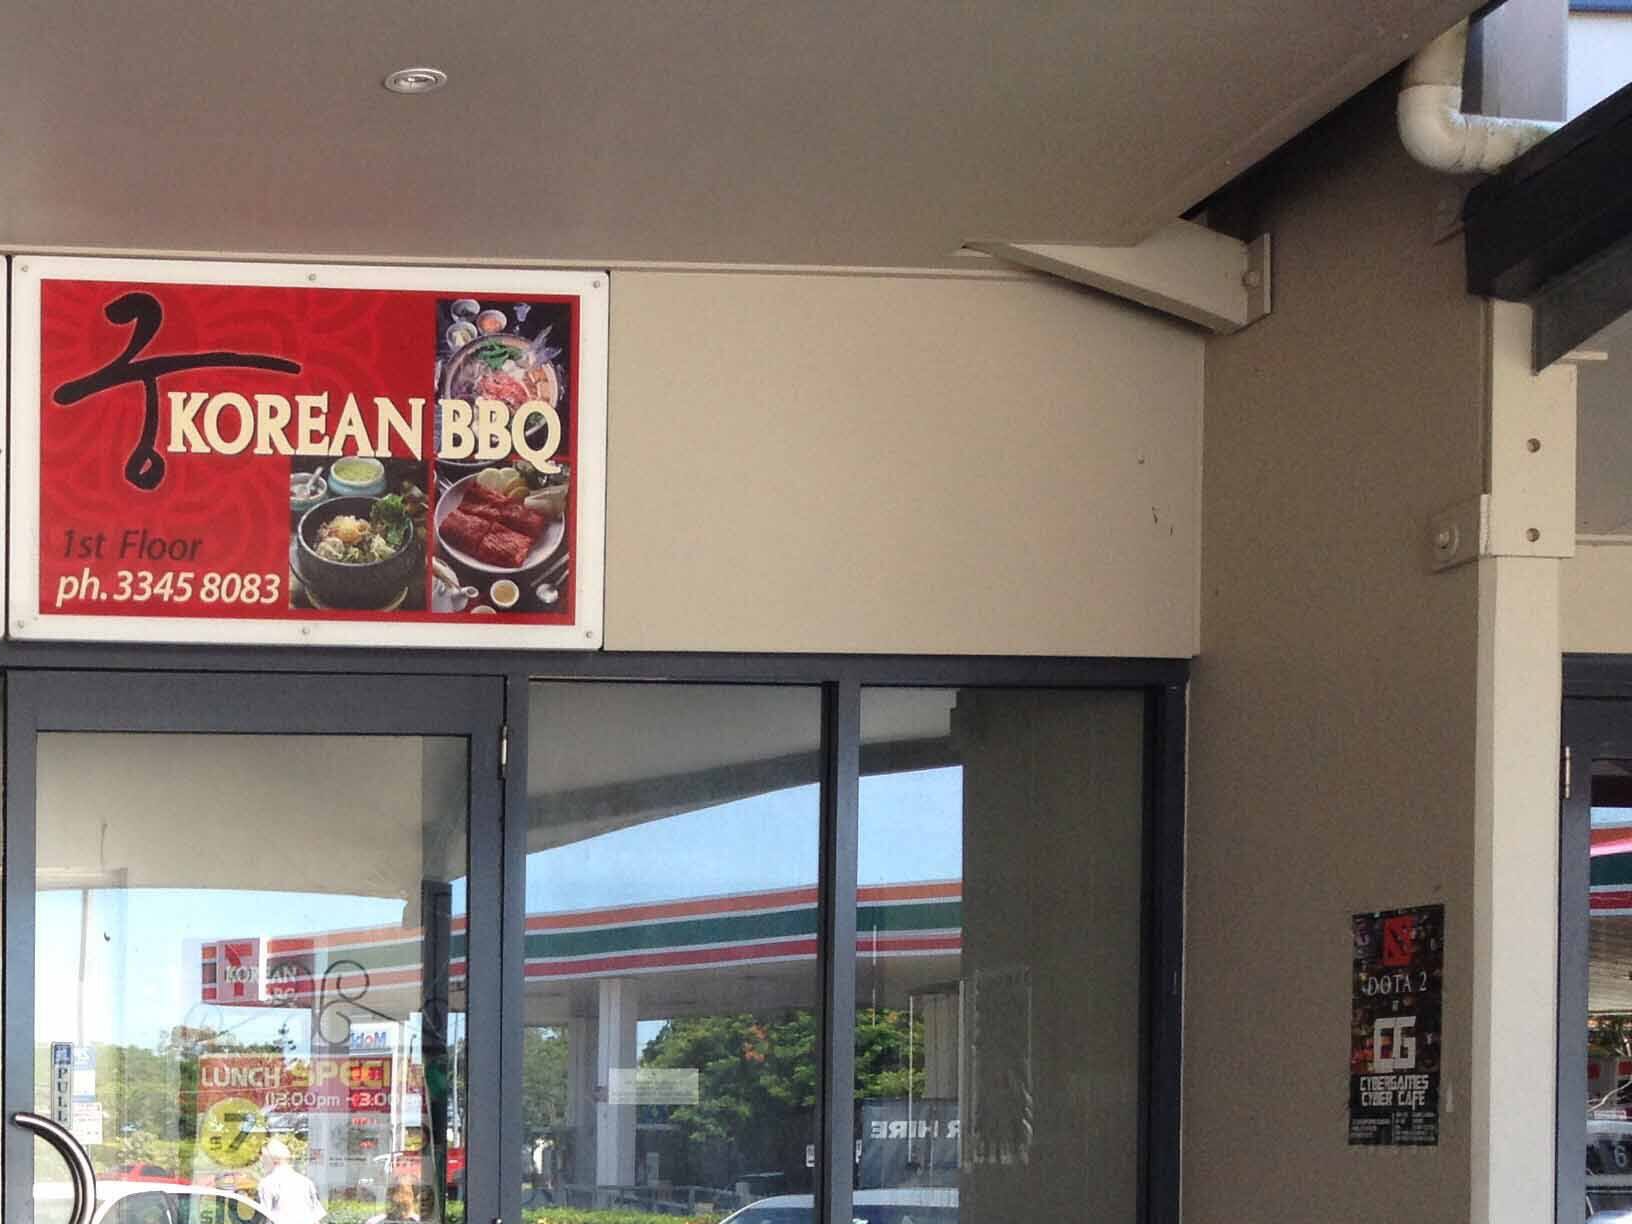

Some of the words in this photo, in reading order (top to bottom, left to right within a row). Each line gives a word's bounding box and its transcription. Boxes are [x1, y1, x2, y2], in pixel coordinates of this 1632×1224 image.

[168, 391, 426, 460] KOREAN
[436, 399, 563, 475] BBQ
[63, 529, 106, 561] 1st
[119, 529, 203, 562] Floor
[202, 573, 280, 605] 8083
[226, 966, 298, 984] KORAN
[1367, 974, 1412, 996] DOTA
[1419, 971, 1427, 991] 2
[201, 1065, 281, 1089] LUNCH
[291, 1060, 425, 1089] SPECI
[57, 1067, 69, 1123] PULL
[1361, 1091, 1393, 1106] CYBER
